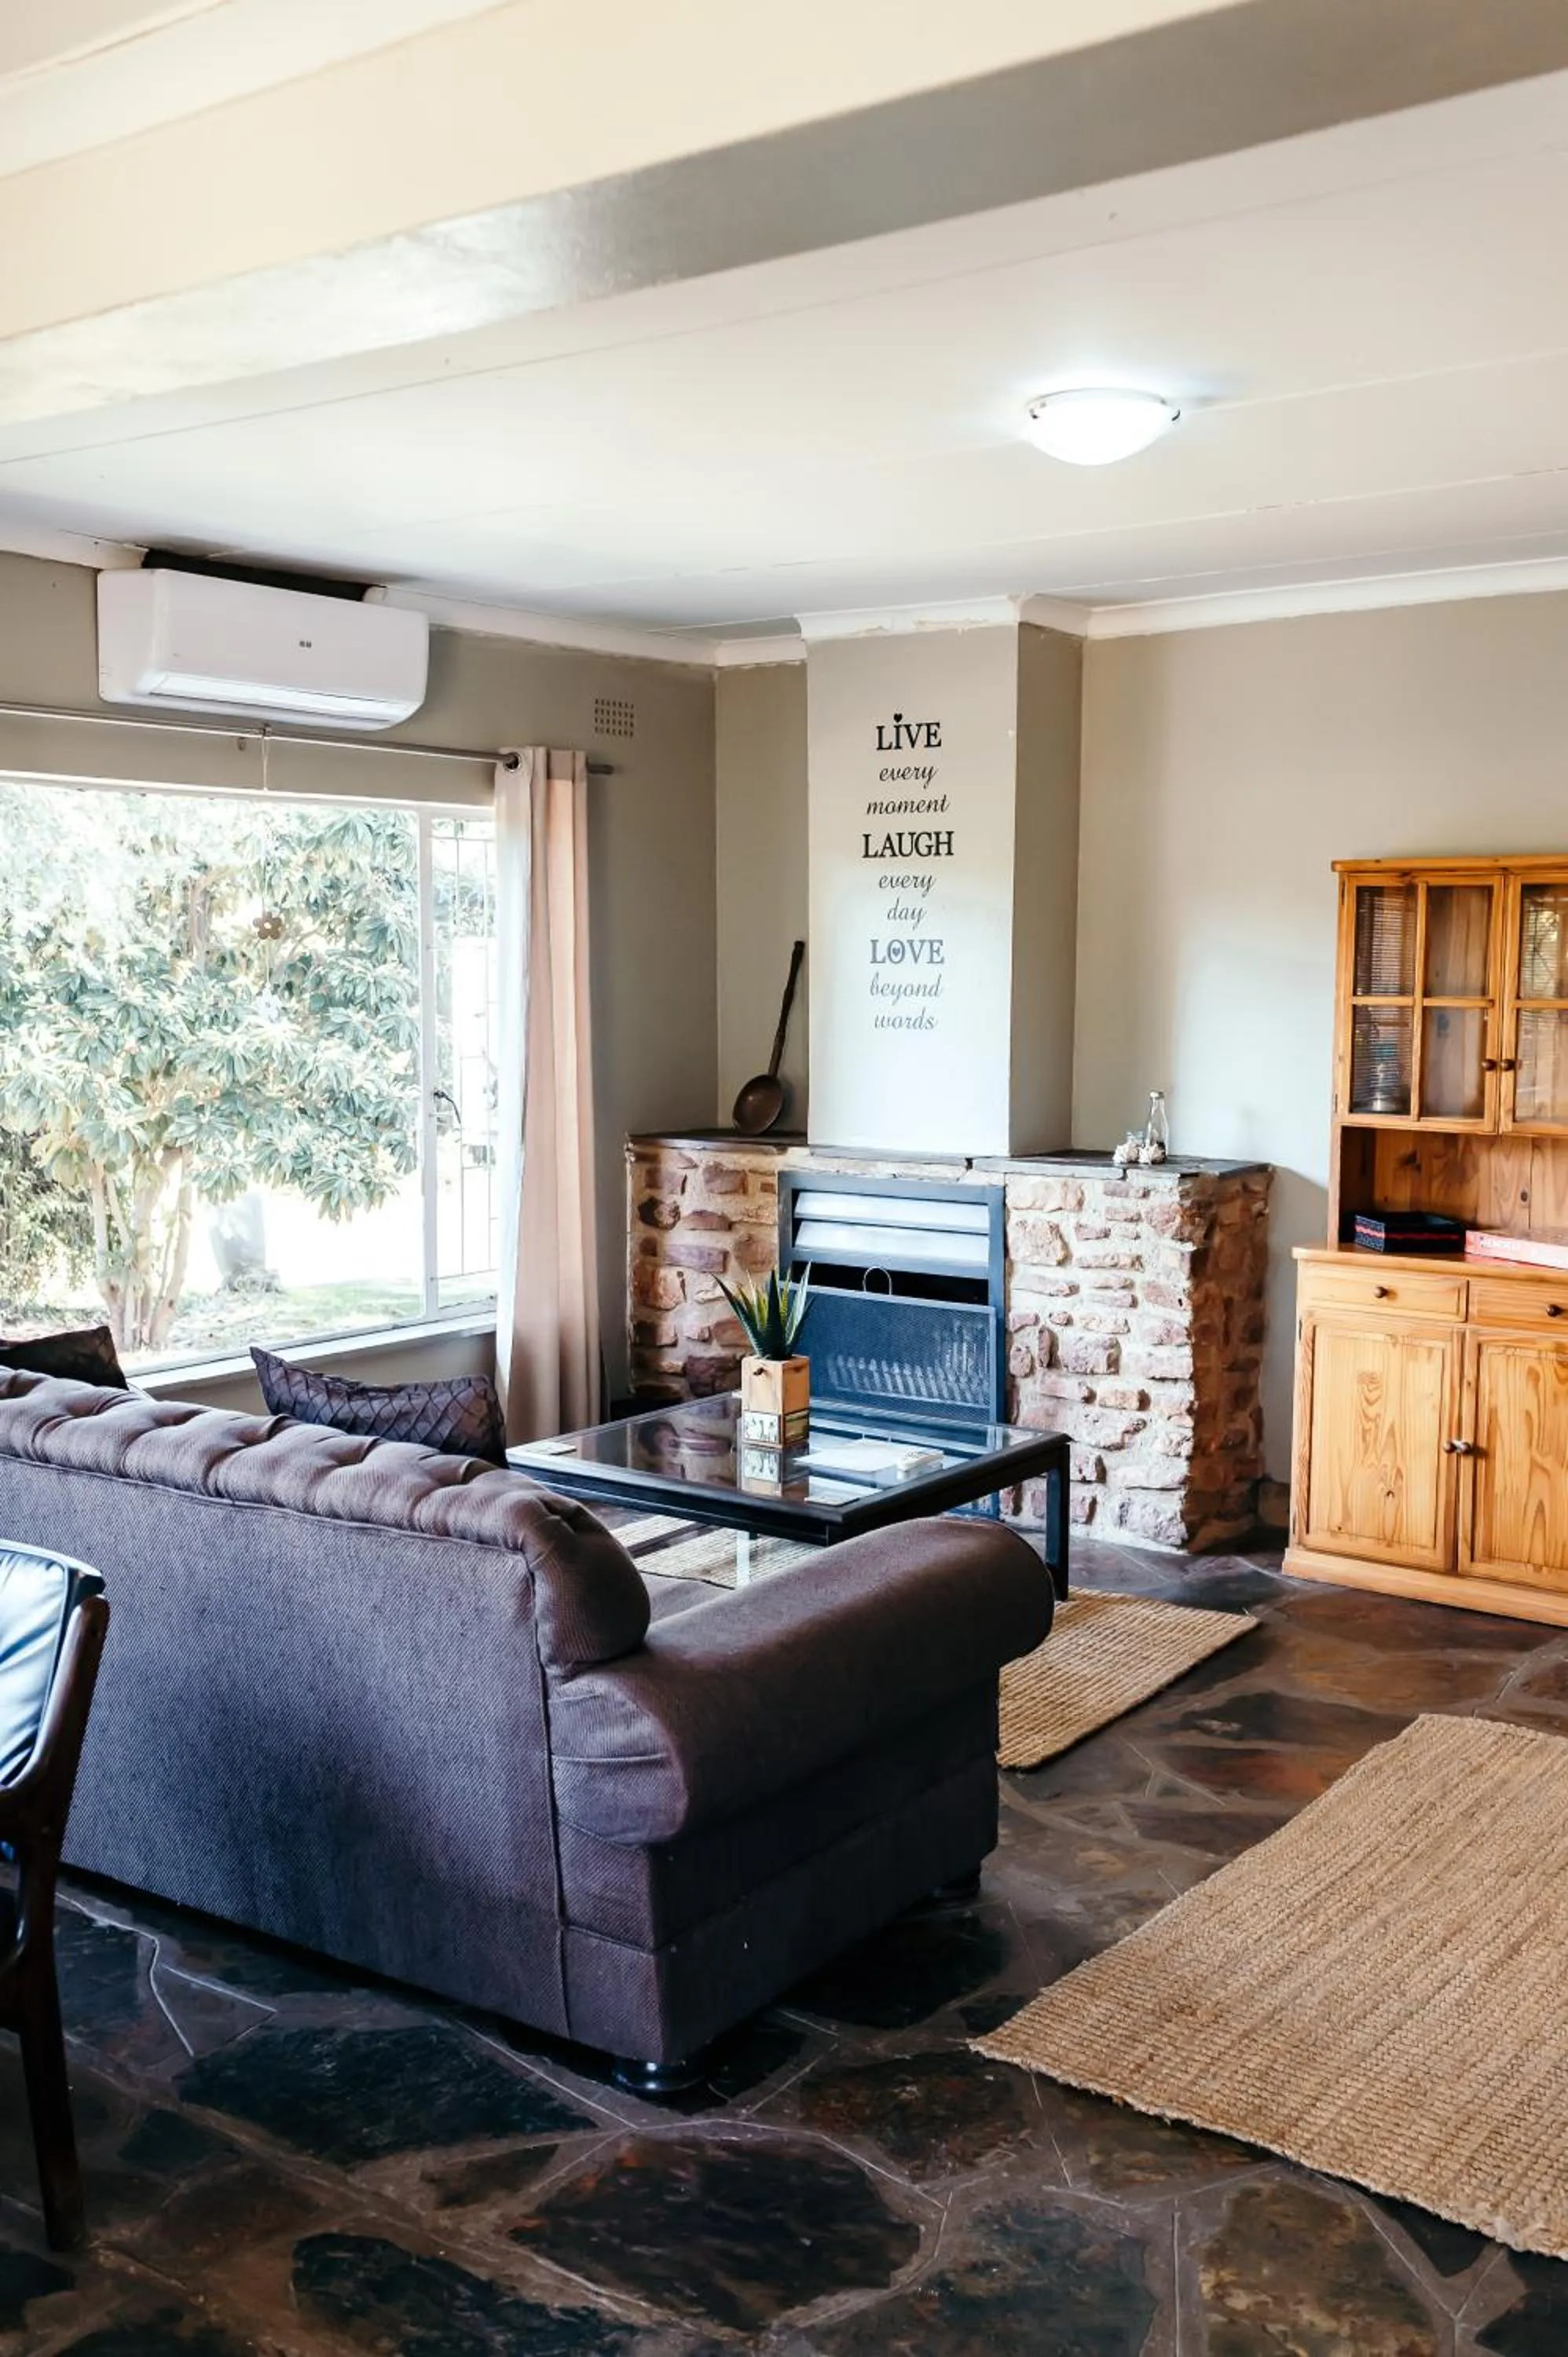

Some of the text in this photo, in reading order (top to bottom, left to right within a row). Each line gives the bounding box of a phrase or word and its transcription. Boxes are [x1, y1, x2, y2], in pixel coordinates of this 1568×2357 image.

[875, 713, 943, 751] LIVE
[878, 765, 939, 790] every
[866, 794, 951, 816] moment
[861, 830, 955, 859] LAUGH
[878, 874, 937, 898] every
[886, 896, 928, 930] day
[870, 938, 945, 966] LOVE
[870, 971, 943, 1006] beyond
[874, 1007, 938, 1031] words
